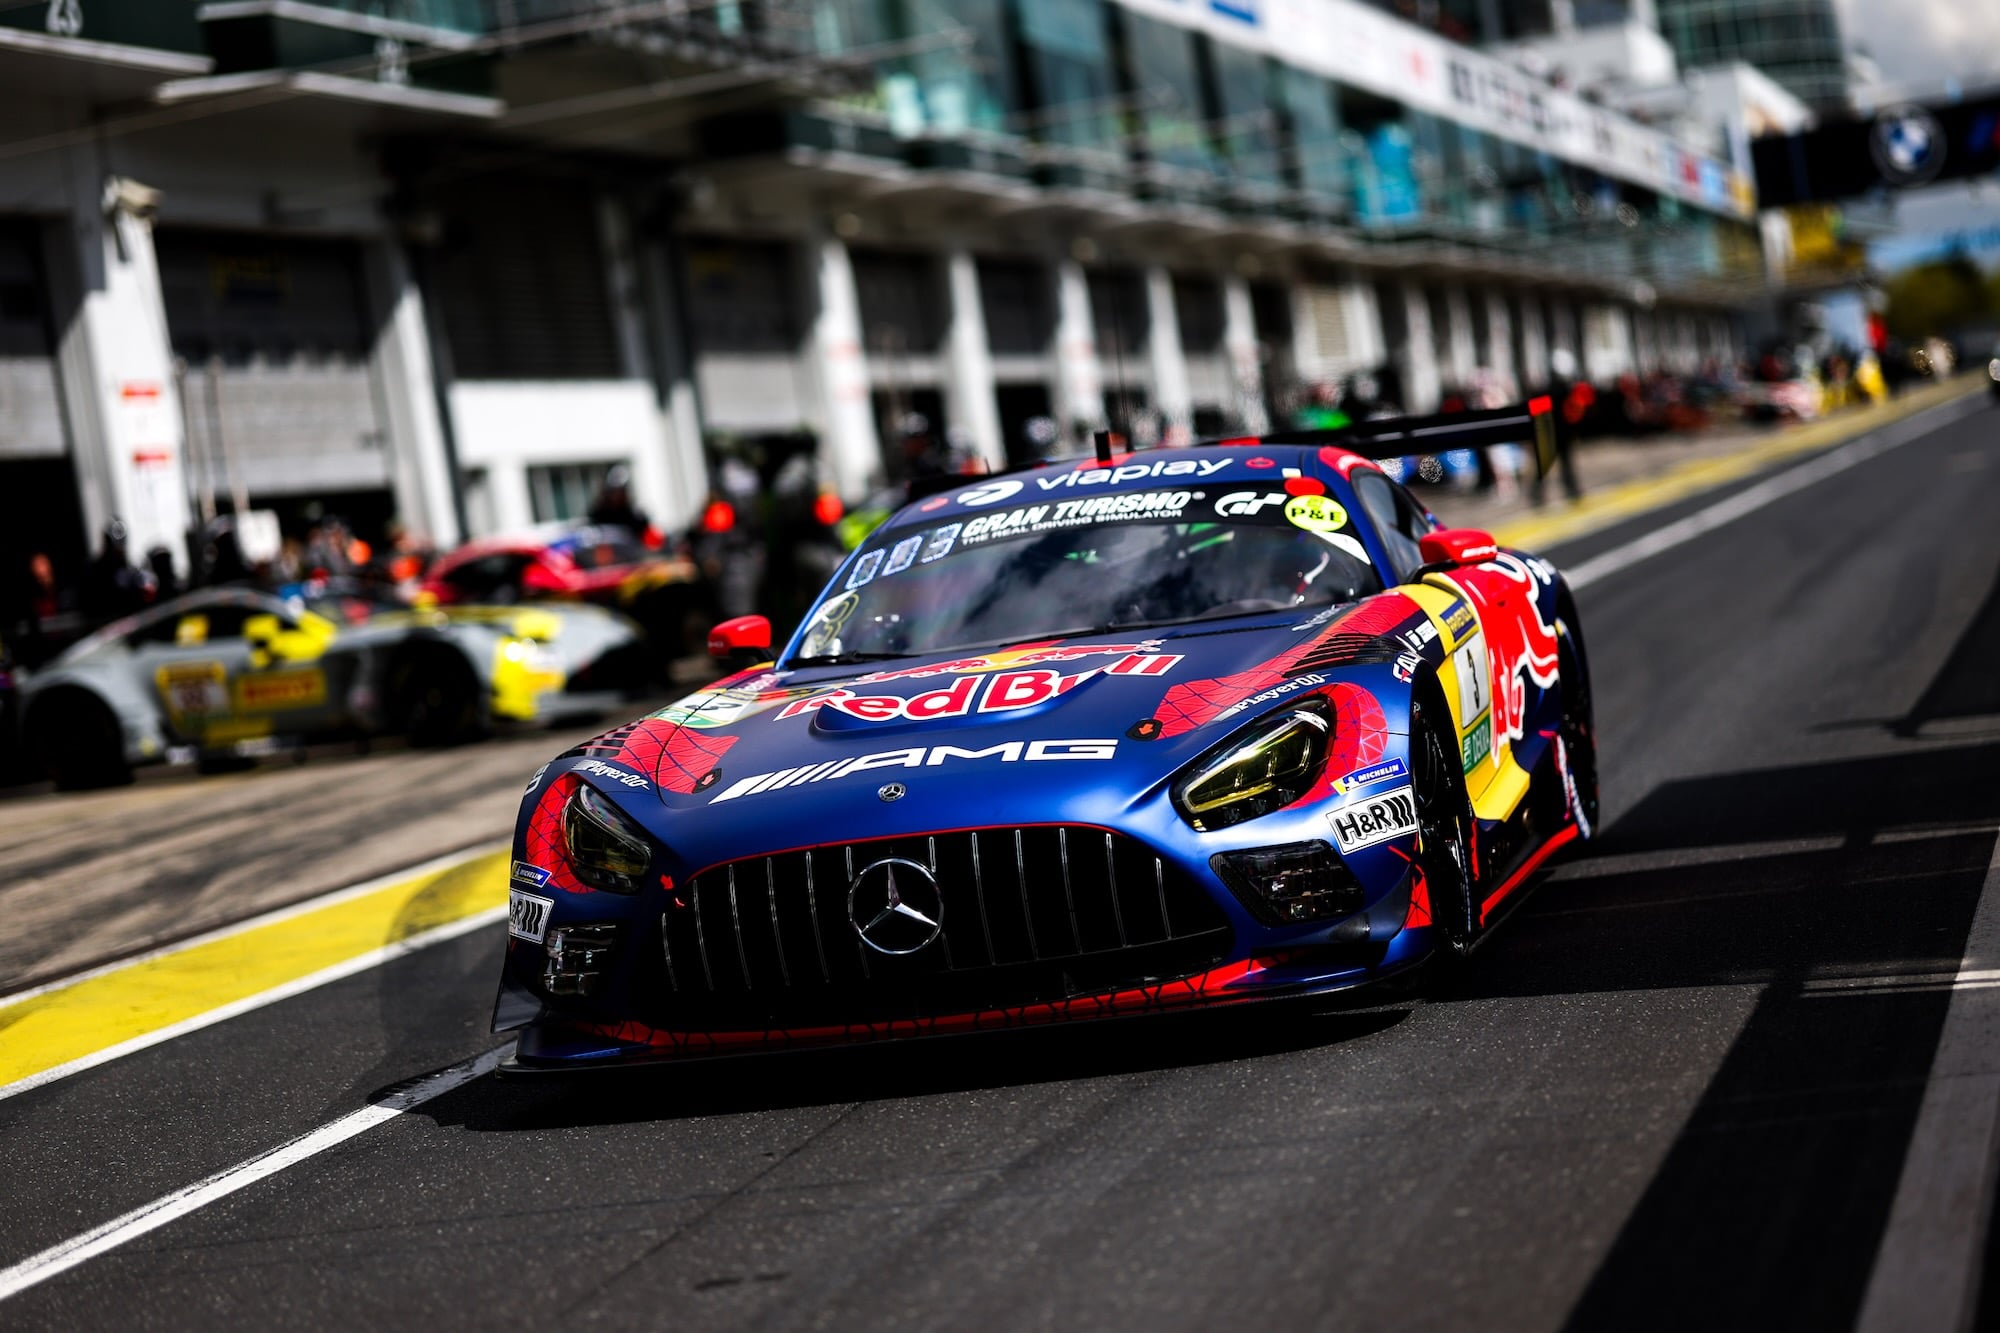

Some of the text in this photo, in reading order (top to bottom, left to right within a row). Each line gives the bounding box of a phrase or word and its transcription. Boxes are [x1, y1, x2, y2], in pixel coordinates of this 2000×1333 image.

[1036, 457, 1234, 490] viaplay
[961, 491, 1191, 538] GRAN TURISMO
[962, 509, 1182, 547] THE REAL DRIVING SIMULATOR
[773, 673, 987, 721] Red
[1465, 647, 1481, 710] 3
[826, 738, 1119, 780] AMG
[1357, 763, 1400, 783] MICHELIN
[1334, 803, 1393, 843] H&R
